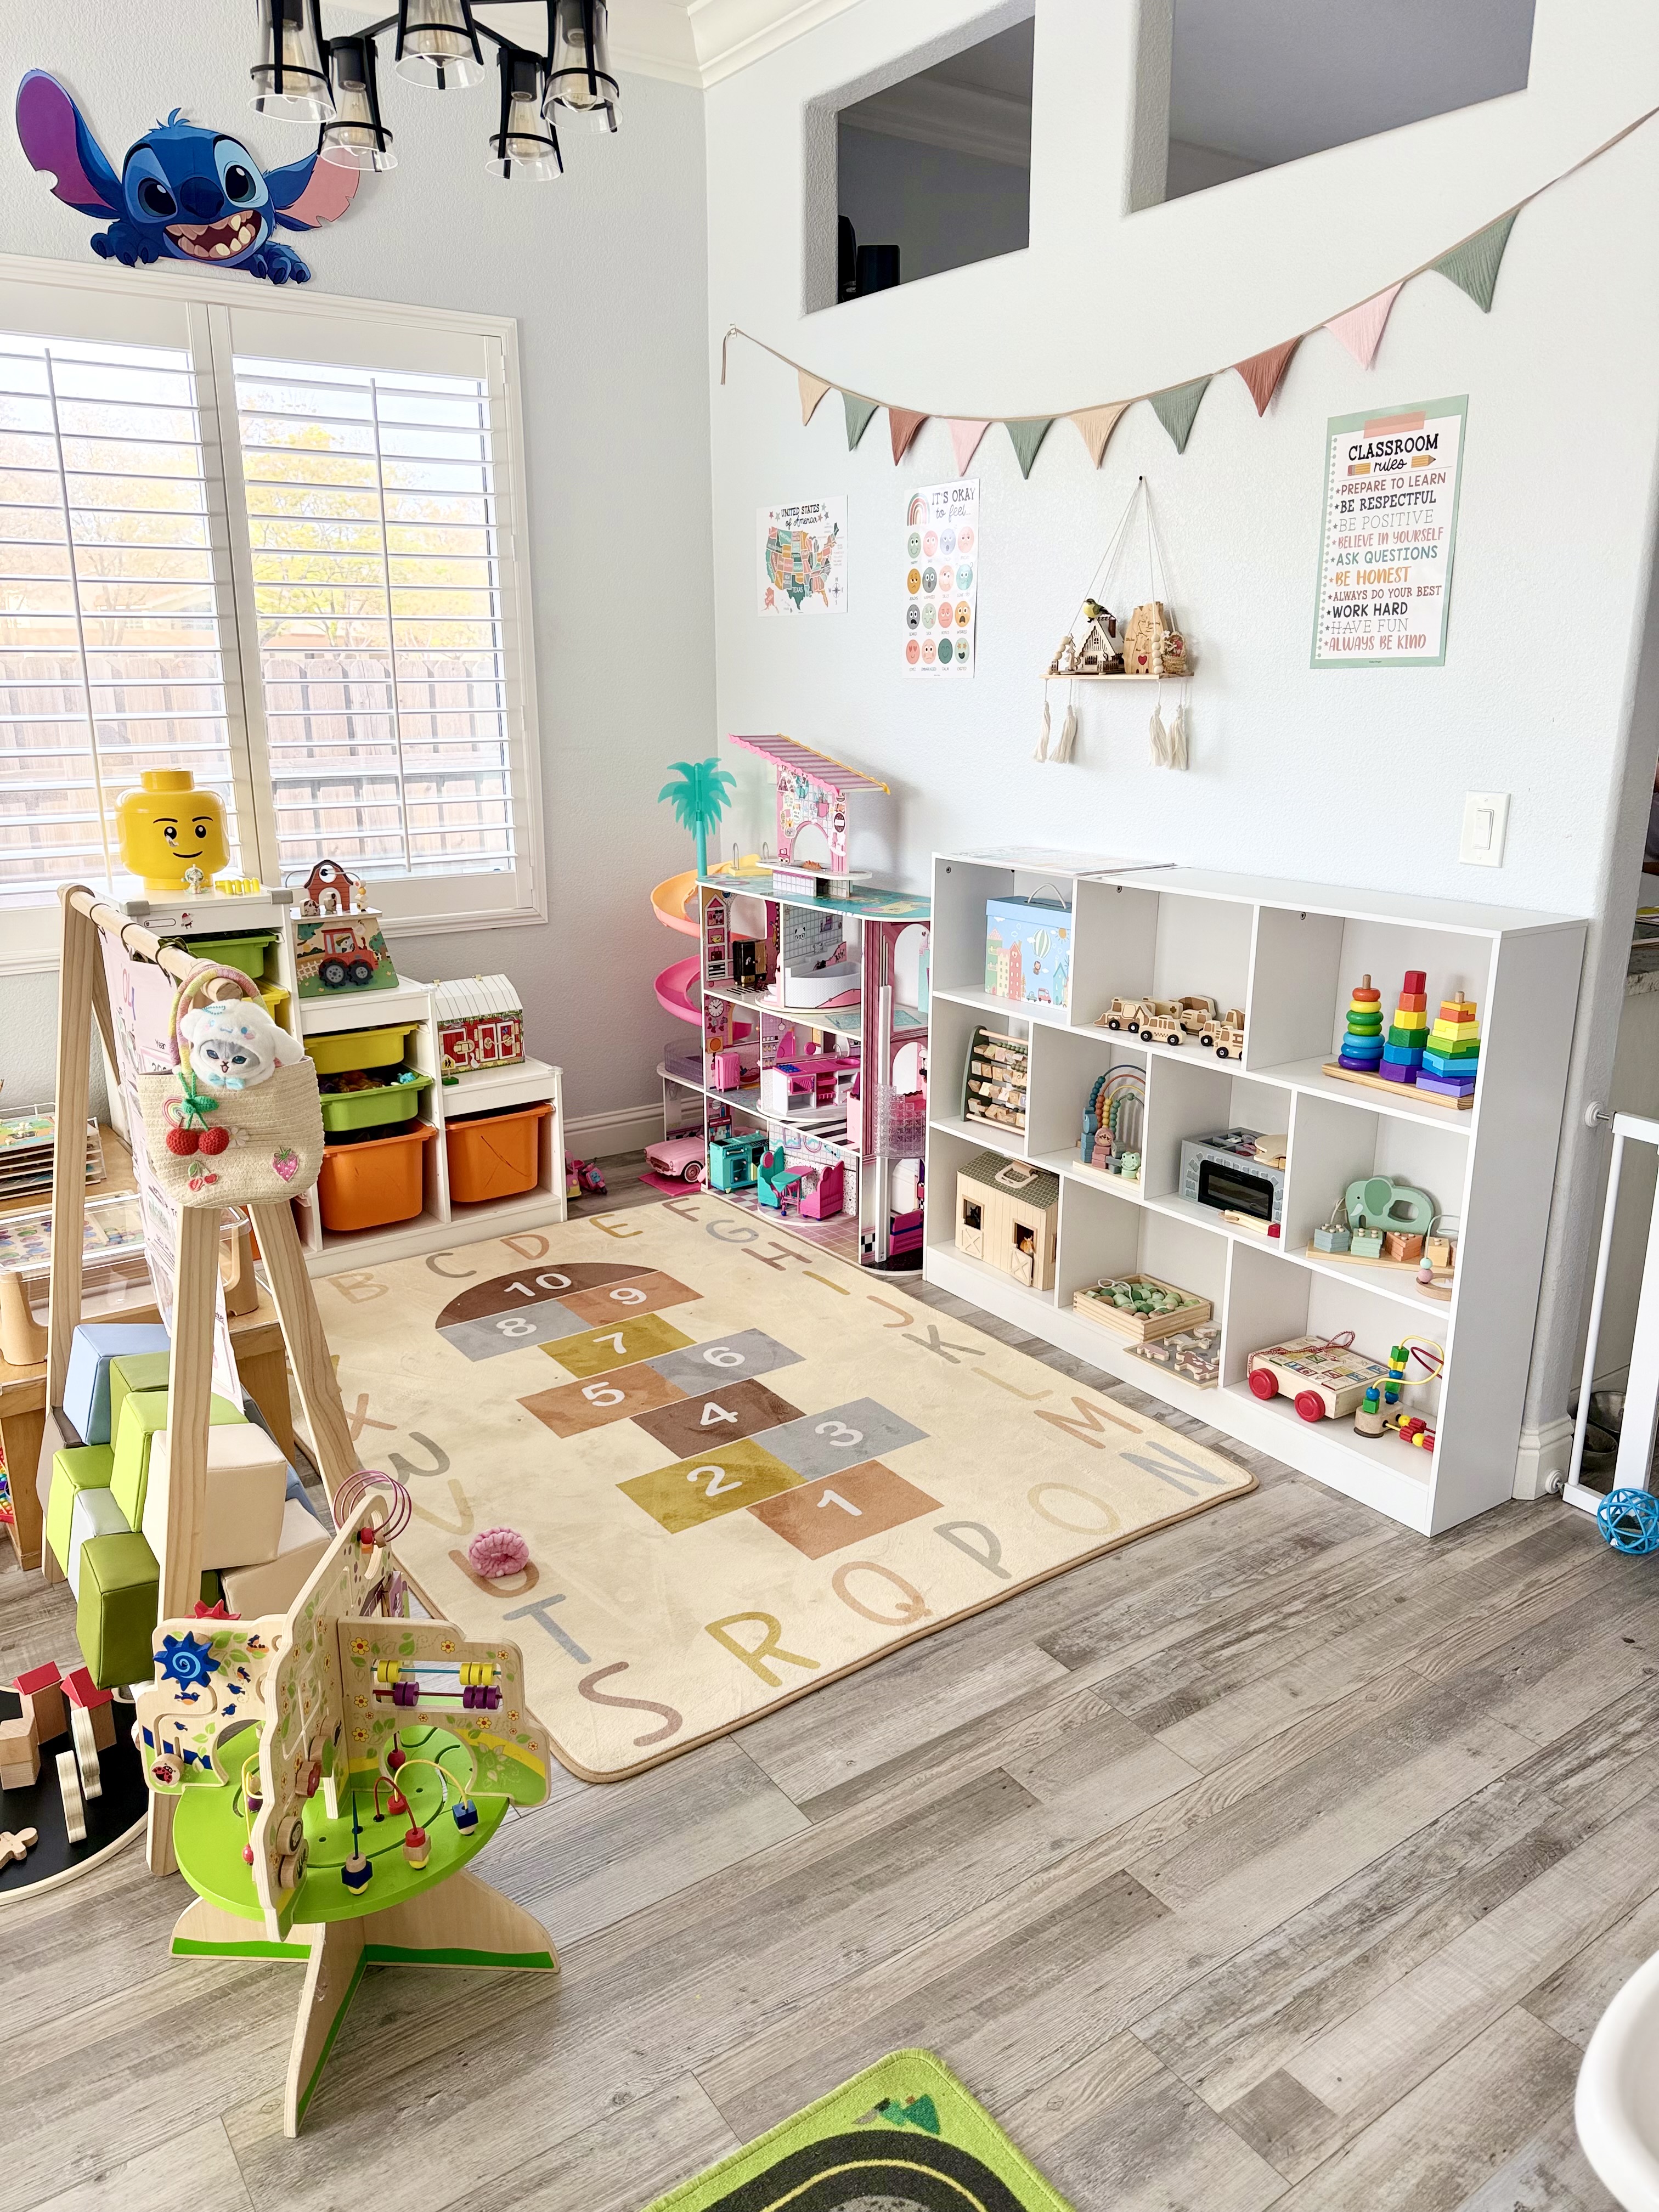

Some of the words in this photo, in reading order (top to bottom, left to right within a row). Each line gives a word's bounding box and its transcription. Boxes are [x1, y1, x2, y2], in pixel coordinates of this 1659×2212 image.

[1348, 433, 1439, 461] CLASSROOM
[1373, 458, 1408, 473] rules
[1341, 479, 1387, 495] PREPARE
[1391, 477, 1404, 489] TO
[1408, 471, 1446, 488] LEARN
[932, 491, 948, 505] IT'S
[952, 488, 975, 502] OKAY
[1340, 499, 1355, 514] BE
[1359, 490, 1436, 511] RESPECTFUL
[781, 507, 800, 517] UNITED
[801, 504, 820, 515] STATES
[936, 507, 946, 519] to
[1338, 517, 1356, 532] BE
[1361, 509, 1434, 530] POSITIVE
[785, 517, 792, 531] of
[1338, 533, 1374, 549] BELIEVE
[1392, 527, 1444, 544] YOURSELF
[1336, 551, 1359, 566] ASK
[1364, 545, 1438, 564] QUESTIONS
[1335, 571, 1351, 586] BE
[1357, 566, 1412, 585] HONEST
[1333, 590, 1368, 602] ALWAYS
[1371, 589, 1384, 600] DO
[1388, 587, 1413, 598] YOUR
[1417, 585, 1442, 597] BEST
[1333, 603, 1369, 618] WORK
[1373, 601, 1408, 616] HARD
[1330, 619, 1372, 634] HAVE
[1377, 618, 1409, 633] FUN
[1329, 635, 1375, 652] ALWAYS
[1379, 635, 1393, 650] BE
[1397, 634, 1426, 650] KIND
[504, 1272, 572, 1298] 10
[495, 1317, 537, 1338] 8
[609, 1287, 647, 1306] 9
[330, 1272, 388, 1304] B
[426, 1252, 477, 1278] C
[500, 1234, 549, 1260] D
[590, 1214, 643, 1239] E
[661, 1198, 700, 1222] F
[706, 1219, 759, 1243] G
[741, 1241, 812, 1271] H
[802, 1270, 850, 1295] I
[867, 1295, 914, 1328] J
[902, 1324, 985, 1364] K
[972, 1367, 1053, 1401] L
[1034, 1396, 1143, 1449] M
[1119, 1441, 1226, 1497] N
[592, 1331, 627, 1354] 7
[581, 1381, 625, 1407] 5
[702, 1346, 746, 1368] 6
[699, 1401, 738, 1426] 4
[686, 1465, 743, 1497] 2
[814, 1420, 864, 1447] 3
[816, 1489, 863, 1517] 1
[344, 1393, 397, 1441] X
[398, 1479, 475, 1536] V
[448, 1549, 540, 1598] U
[503, 1593, 591, 1664] T
[578, 1661, 683, 1747] S
[704, 1611, 821, 1688] R
[831, 1561, 934, 1627] Q
[933, 1521, 1012, 1579] P
[1027, 1482, 1121, 1535] O
